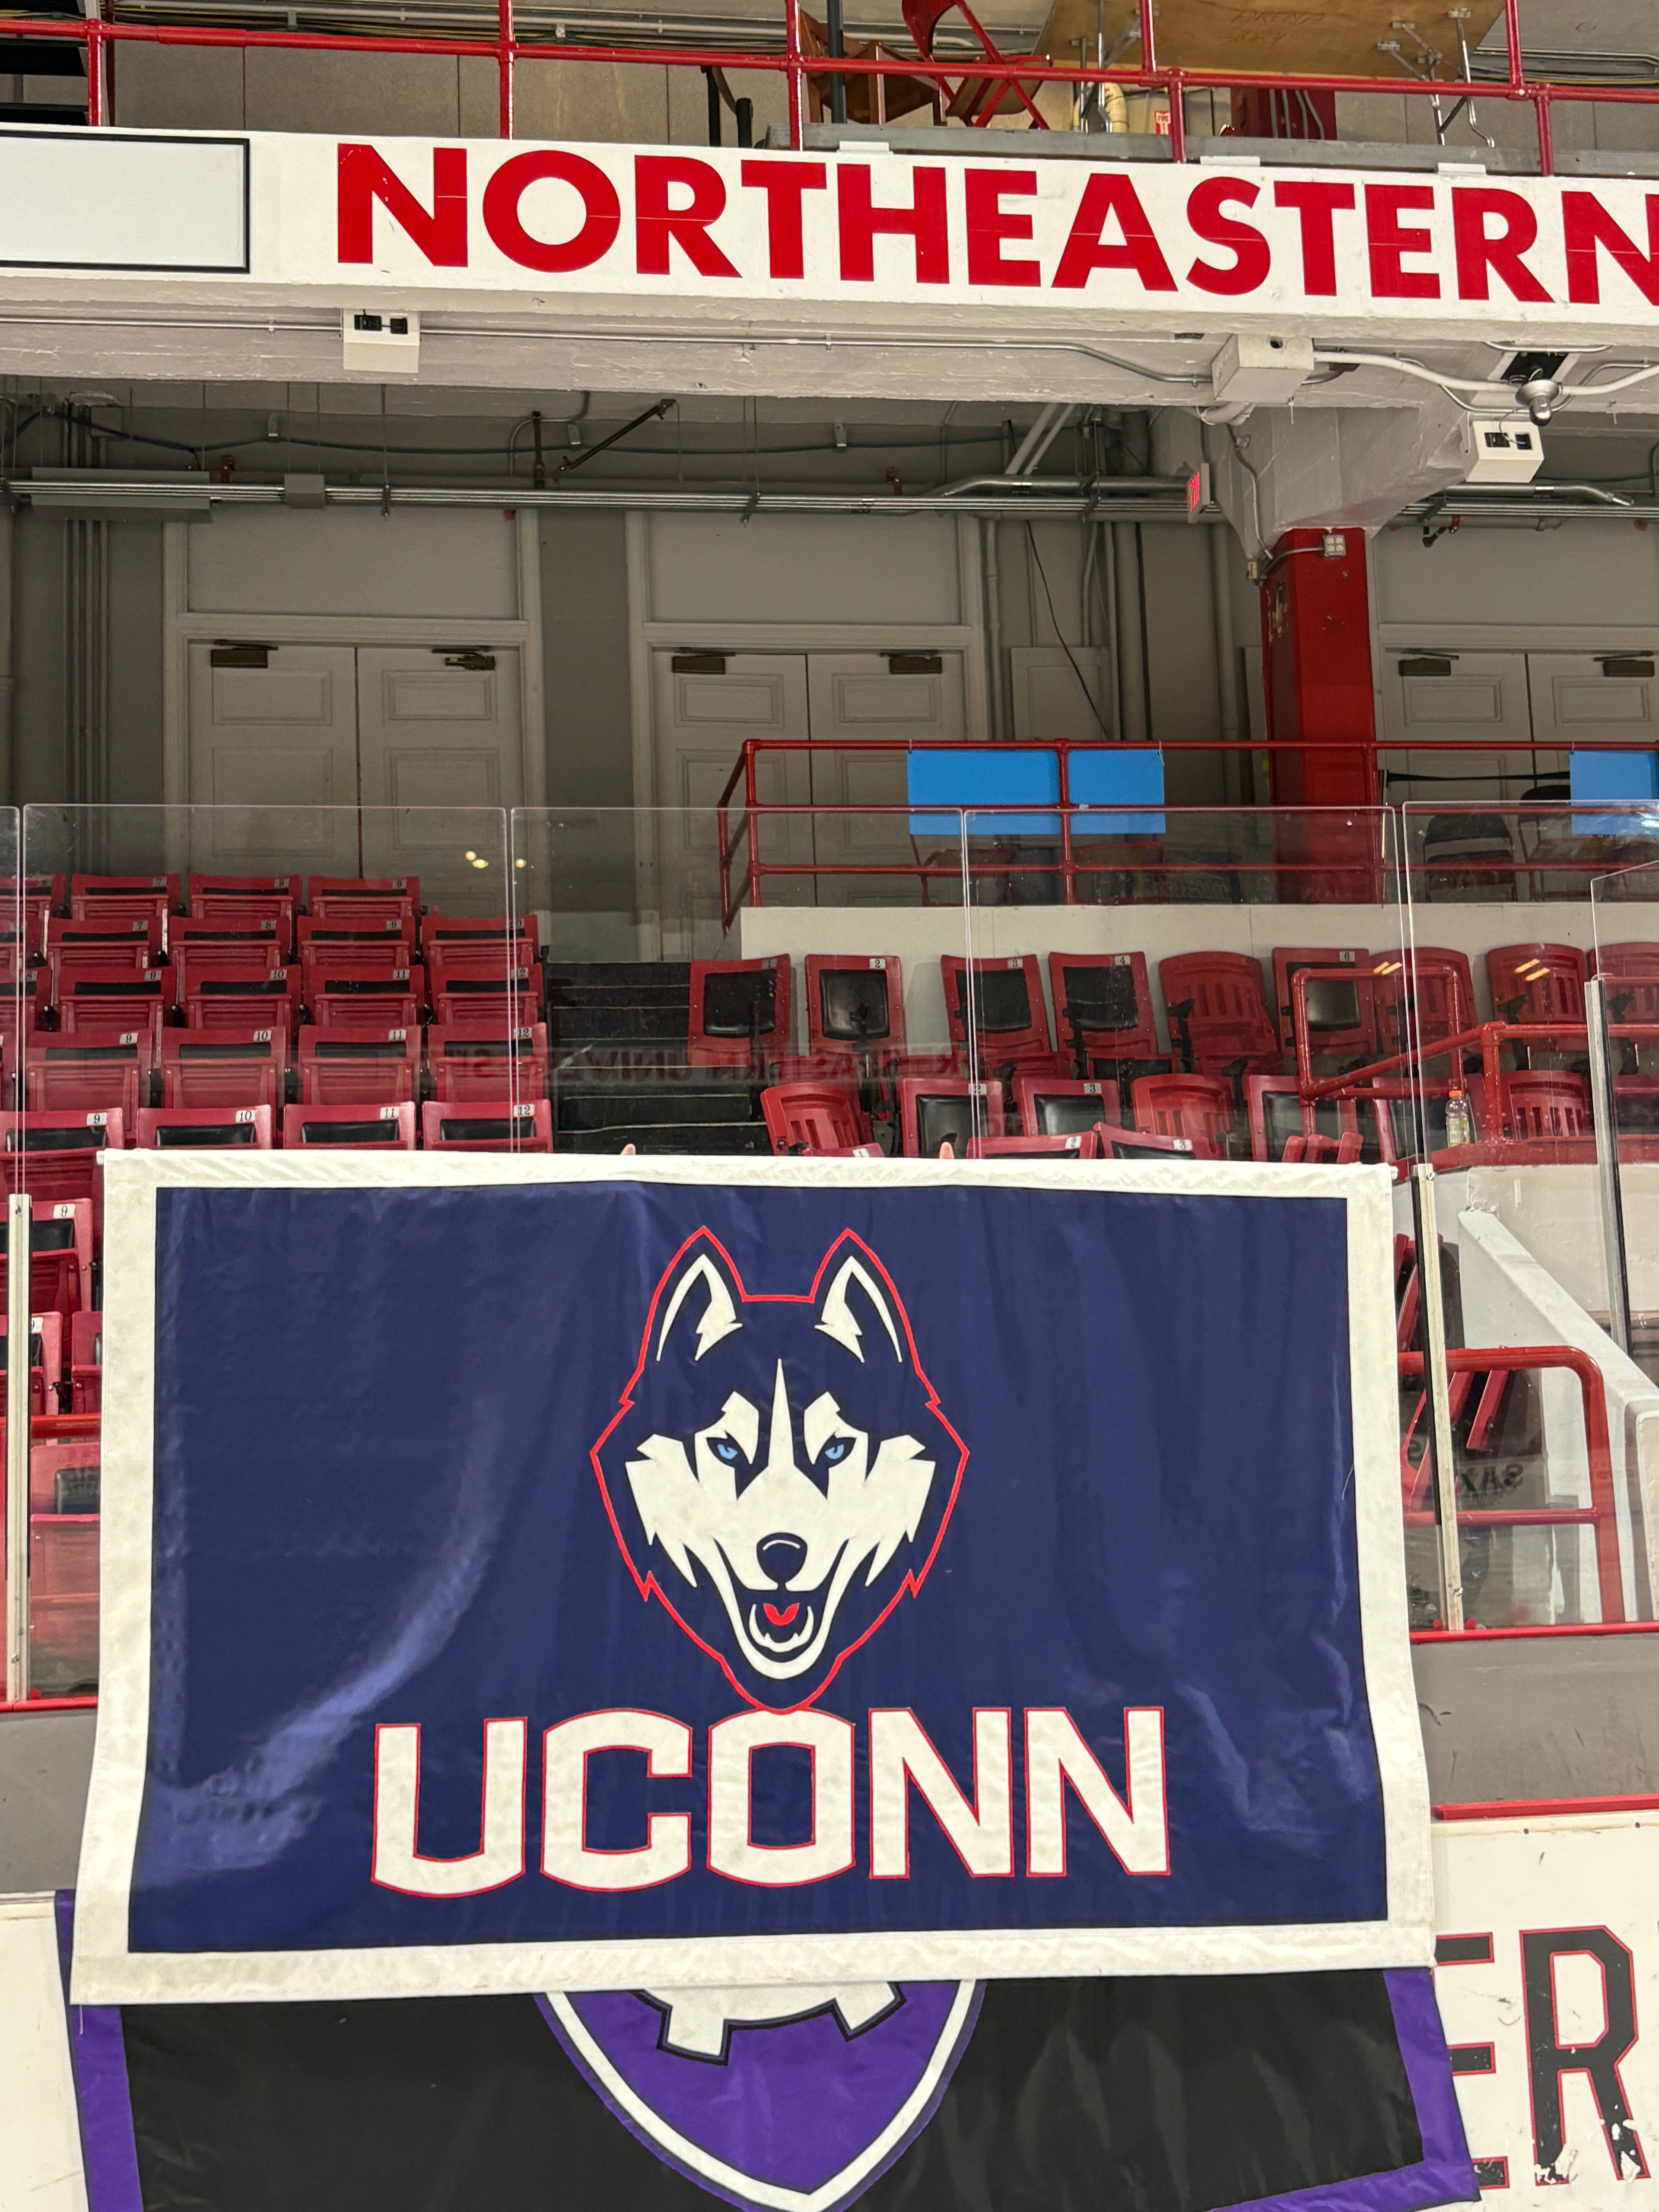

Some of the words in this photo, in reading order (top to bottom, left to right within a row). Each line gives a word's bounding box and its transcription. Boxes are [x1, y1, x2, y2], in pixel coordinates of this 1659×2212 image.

[338, 143, 1659, 306] NORTHEASTERN
[874, 960, 880, 968] 2
[273, 970, 284, 979] 10
[397, 970, 405, 979] 11
[256, 1030, 268, 1041] 10
[393, 1030, 401, 1040] 11
[518, 1028, 529, 1038] 12
[126, 1033, 132, 1044] 9
[1090, 1084, 1095, 1093] 3
[385, 1108, 394, 1118] 11
[518, 1105, 531, 1116] 12
[94, 1114, 100, 1124] 9
[240, 1110, 252, 1122] 10
[61, 1206, 68, 1217] 9
[371, 1707, 1171, 1898] UCONN
